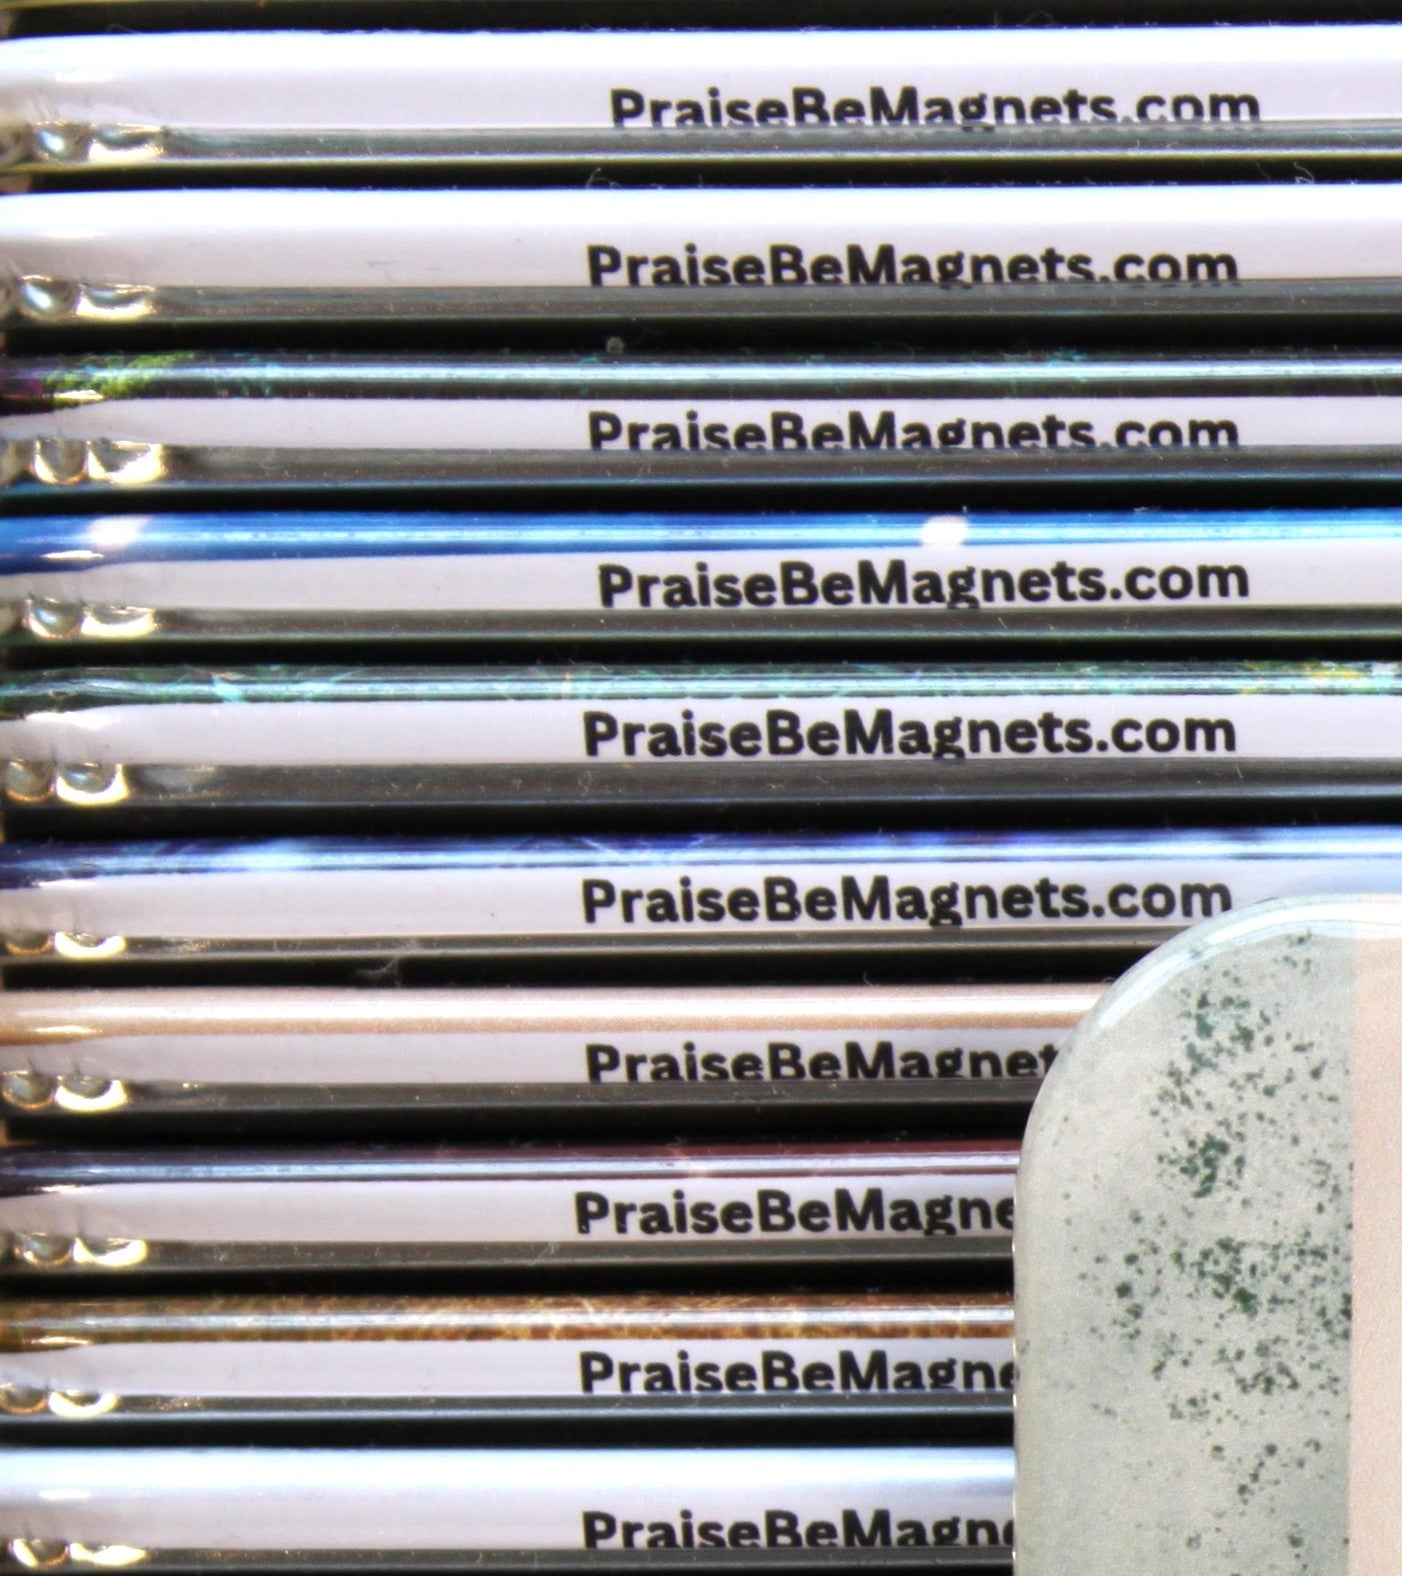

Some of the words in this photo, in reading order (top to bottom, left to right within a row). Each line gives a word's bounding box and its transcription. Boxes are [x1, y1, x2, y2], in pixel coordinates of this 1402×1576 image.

[587, 243, 1237, 288] PraiseBeMagnets.com
[599, 560, 1248, 609] PraiseBeMagnets.com
[584, 709, 1236, 760] PraiseBeMagnets.com
[582, 875, 1232, 927] PraiseBeMagnets.com
